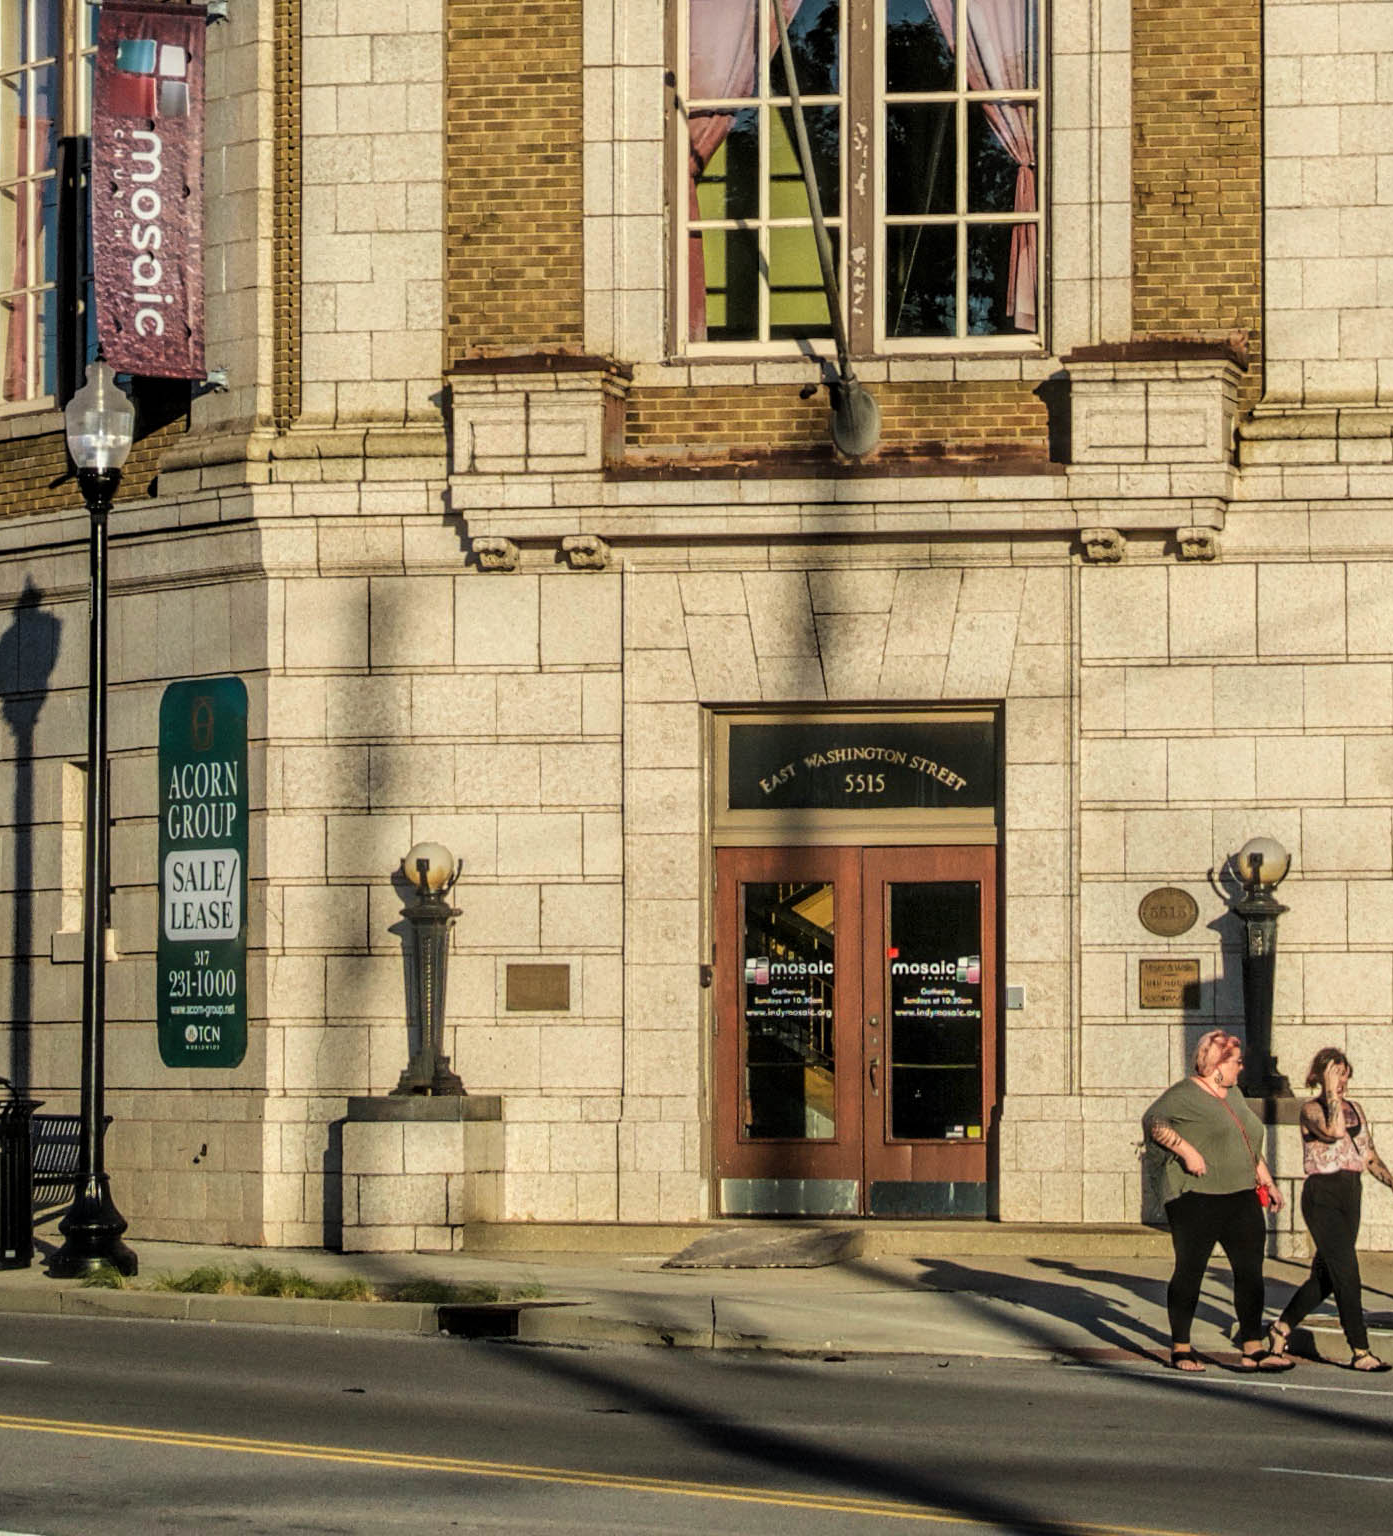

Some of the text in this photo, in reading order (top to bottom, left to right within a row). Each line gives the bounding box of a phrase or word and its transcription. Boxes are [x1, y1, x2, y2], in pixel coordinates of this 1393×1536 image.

[113, 128, 125, 239] CHURCH
[131, 130, 174, 338] mosaic
[168, 761, 239, 800] ACORN
[759, 747, 967, 795] EAST WASHINGTON STREET
[845, 773, 886, 793] 5515
[168, 802, 237, 839] GROUP
[172, 858, 238, 899] SALE/
[171, 901, 234, 931] LEASE
[194, 950, 210, 966] 317
[770, 961, 835, 976] mosaic
[892, 961, 956, 976] mosaic
[168, 969, 237, 998] 231-1000
[771, 987, 806, 997] Gathering
[920, 987, 956, 997] Gathering
[745, 1008, 833, 1018] www.indymosaic.org
[894, 1008, 982, 1018] www.indymosaic.org
[197, 1025, 221, 1042] TCN
